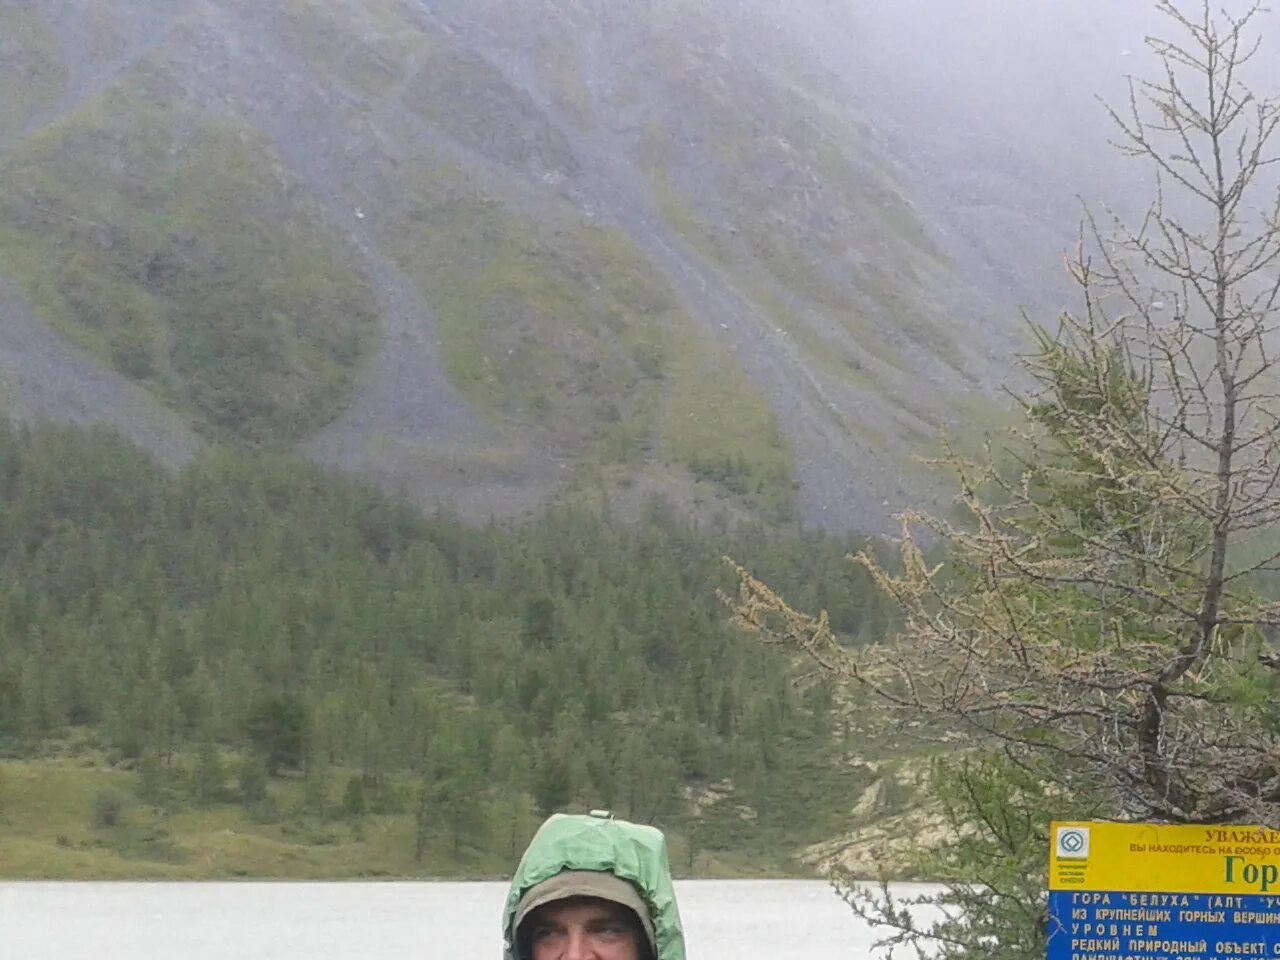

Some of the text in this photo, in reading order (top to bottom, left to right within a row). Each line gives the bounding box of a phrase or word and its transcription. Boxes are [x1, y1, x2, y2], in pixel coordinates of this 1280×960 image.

[1130, 844, 1147, 852] ВЫ
[1149, 844, 1216, 854] НАХОДИТЕСЬ
[1218, 846, 1233, 854] НА
[1073, 893, 1110, 905] ГОРА
[1072, 908, 1087, 920] ИЗ
[1096, 908, 1170, 922] КРУПНЕЙШИХ
[1180, 911, 1225, 923] ГОРНЫХ
[1234, 912, 1280, 924] ВЕРШИН
[1072, 924, 1157, 936] УРОВНЕМ
[1072, 937, 1119, 951] РЕДКИЙ
[1129, 939, 1206, 954] ПРИРОДНЫЙ
[1216, 942, 1265, 954] ОБЪЕКТ
[1274, 943, 1280, 955] С
